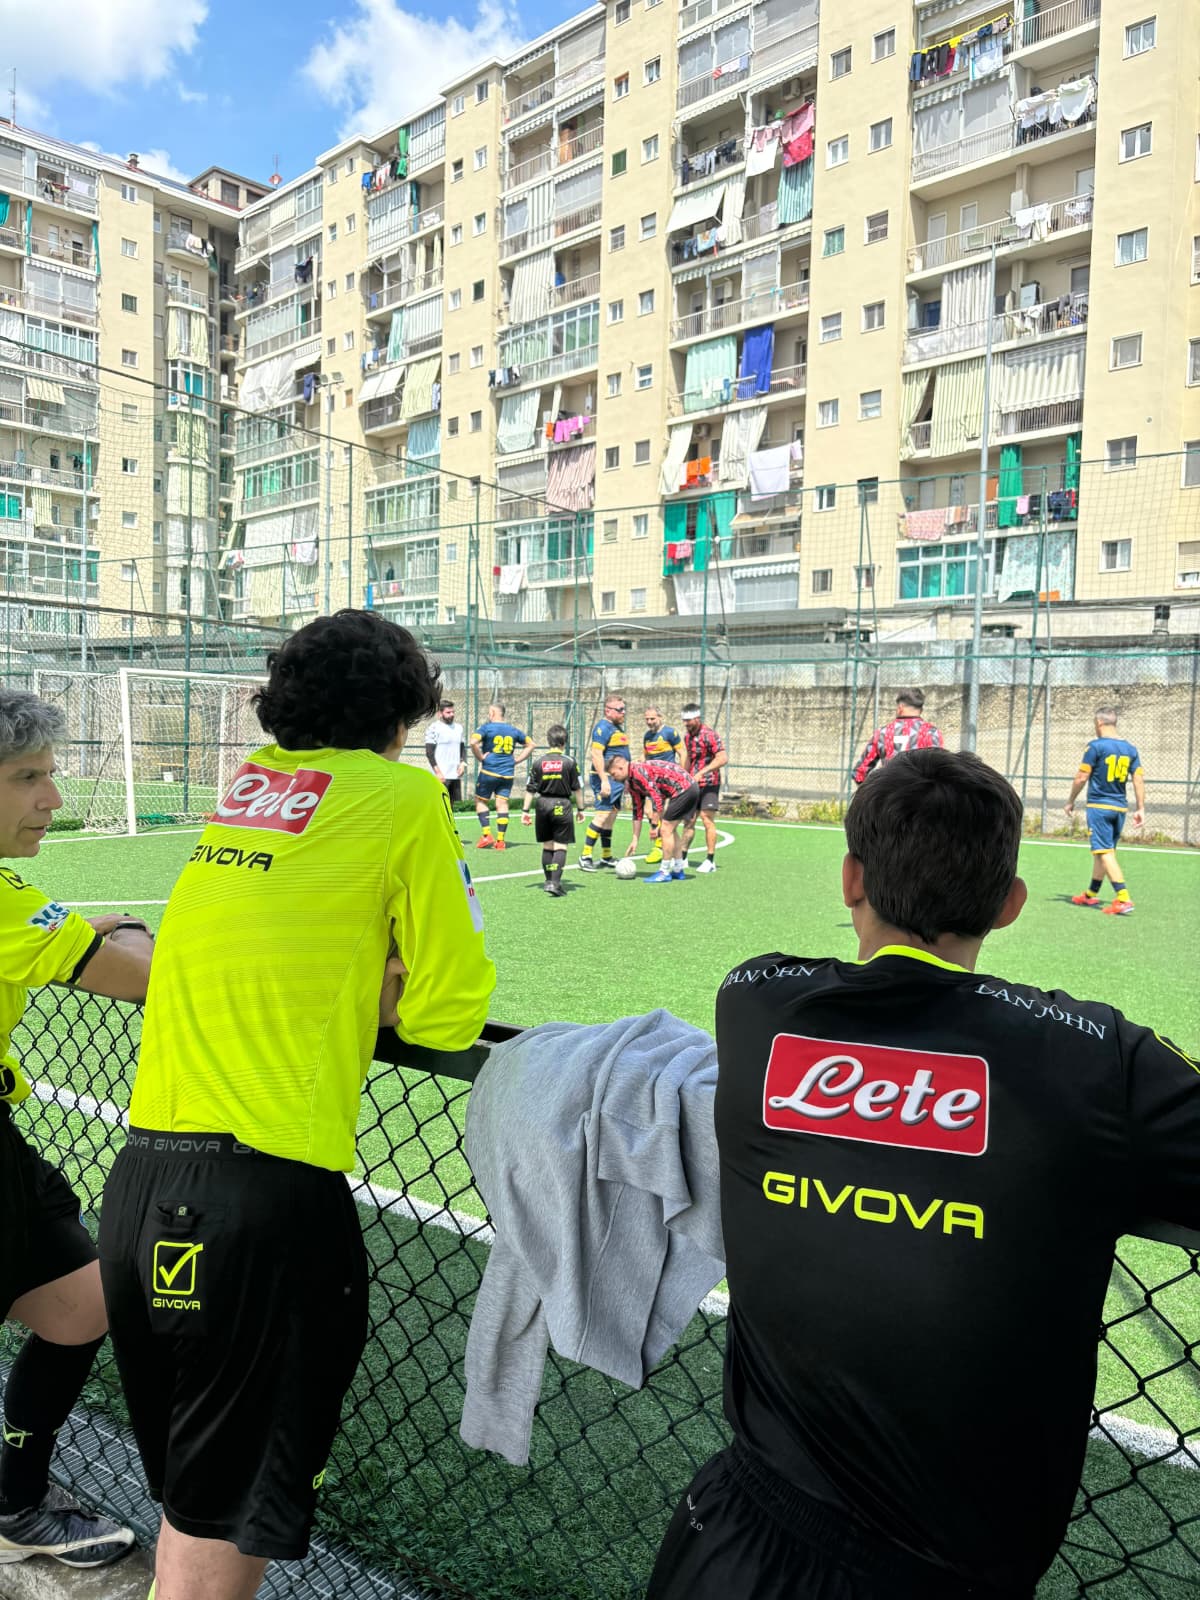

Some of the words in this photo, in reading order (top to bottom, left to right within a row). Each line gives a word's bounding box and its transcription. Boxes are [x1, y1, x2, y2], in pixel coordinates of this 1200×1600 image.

[189, 845, 274, 872] GIVOVA
[974, 983, 1036, 1010] DAN
[1035, 1004, 1107, 1040] JOHN
[768, 1055, 982, 1130] Lete
[128, 1134, 150, 1150] OVA
[154, 1138, 221, 1153] GIVOVA
[762, 1171, 985, 1239] GIVOVA
[152, 1297, 201, 1311] GIVOVA
